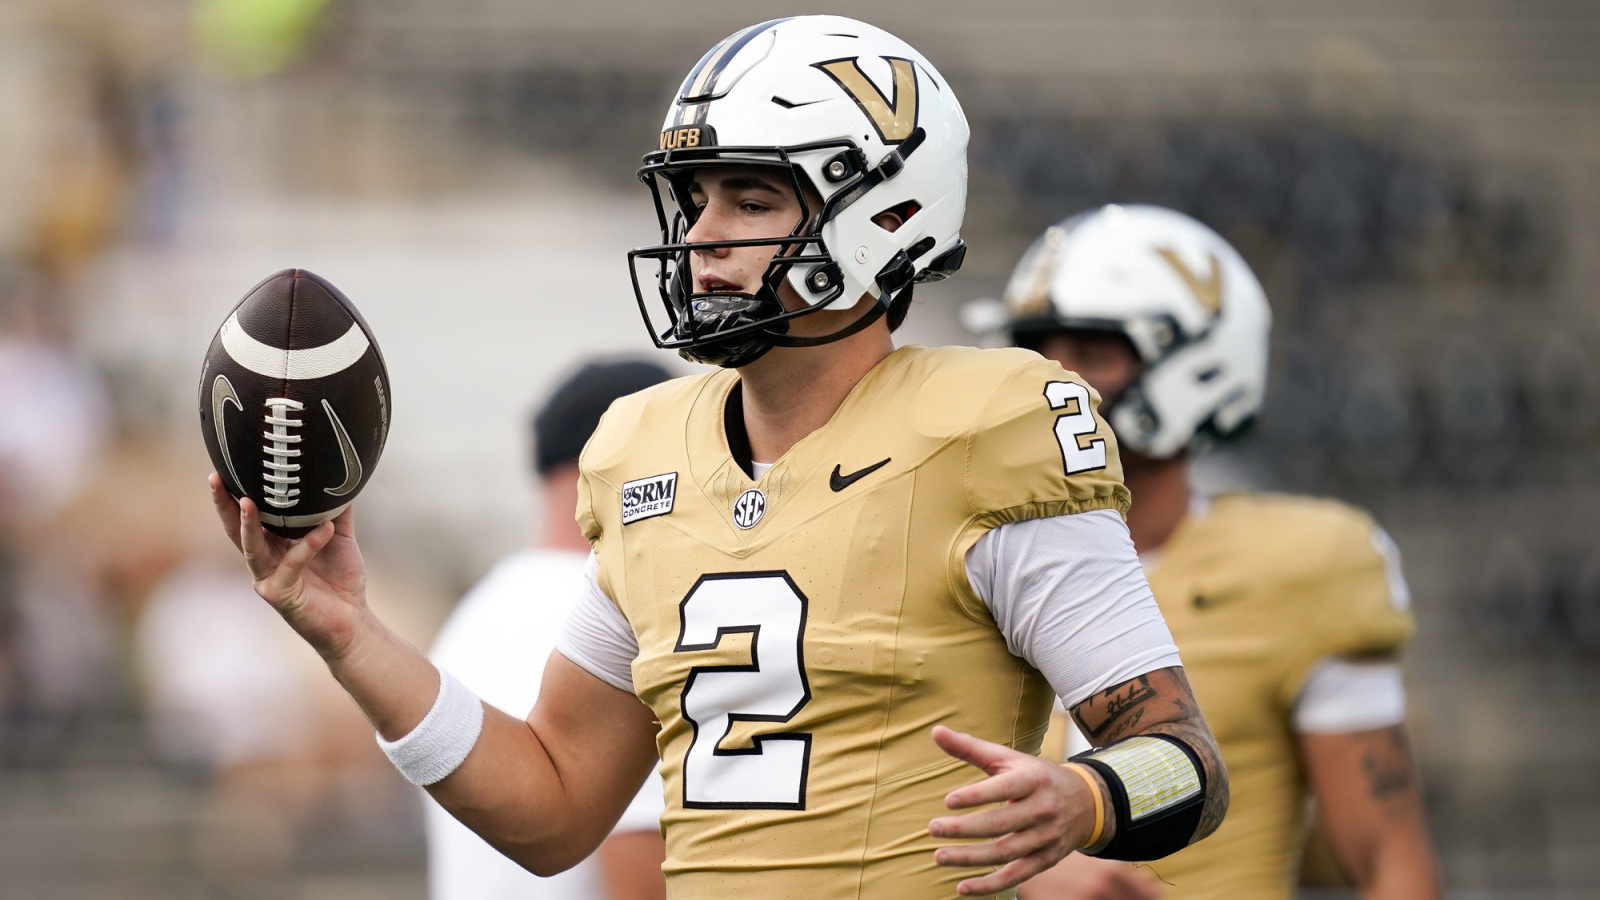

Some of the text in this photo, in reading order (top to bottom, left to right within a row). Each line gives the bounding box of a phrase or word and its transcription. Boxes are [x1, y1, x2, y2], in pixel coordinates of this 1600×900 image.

[809, 55, 920, 146] V
[660, 128, 701, 150] VUFB
[1043, 380, 1107, 476] 2
[623, 500, 672, 518] CONCRETE
[630, 478, 674, 507] SRM
[734, 491, 764, 528] SEC
[673, 569, 813, 811] 2
